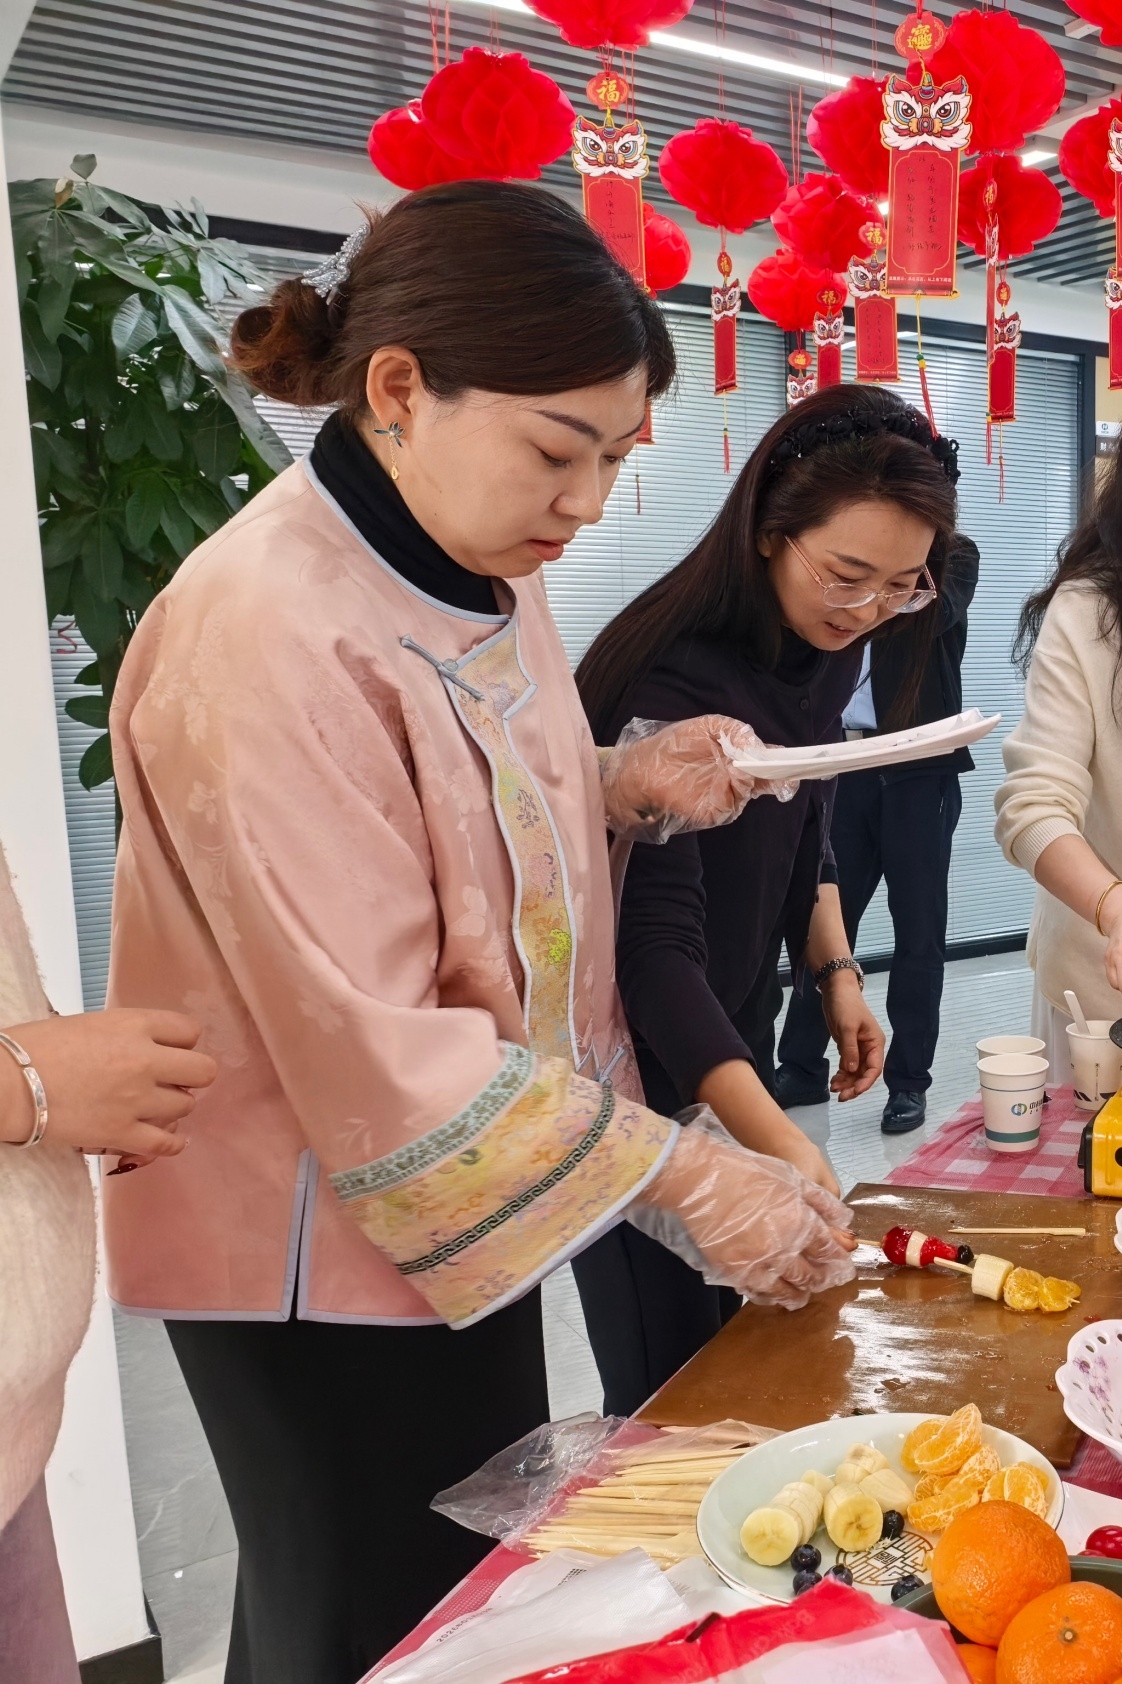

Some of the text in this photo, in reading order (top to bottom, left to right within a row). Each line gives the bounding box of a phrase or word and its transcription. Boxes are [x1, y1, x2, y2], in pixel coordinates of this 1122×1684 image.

[596, 79, 620, 104] 福
[865, 227, 883, 245] 福
[821, 290, 837, 304] 福
